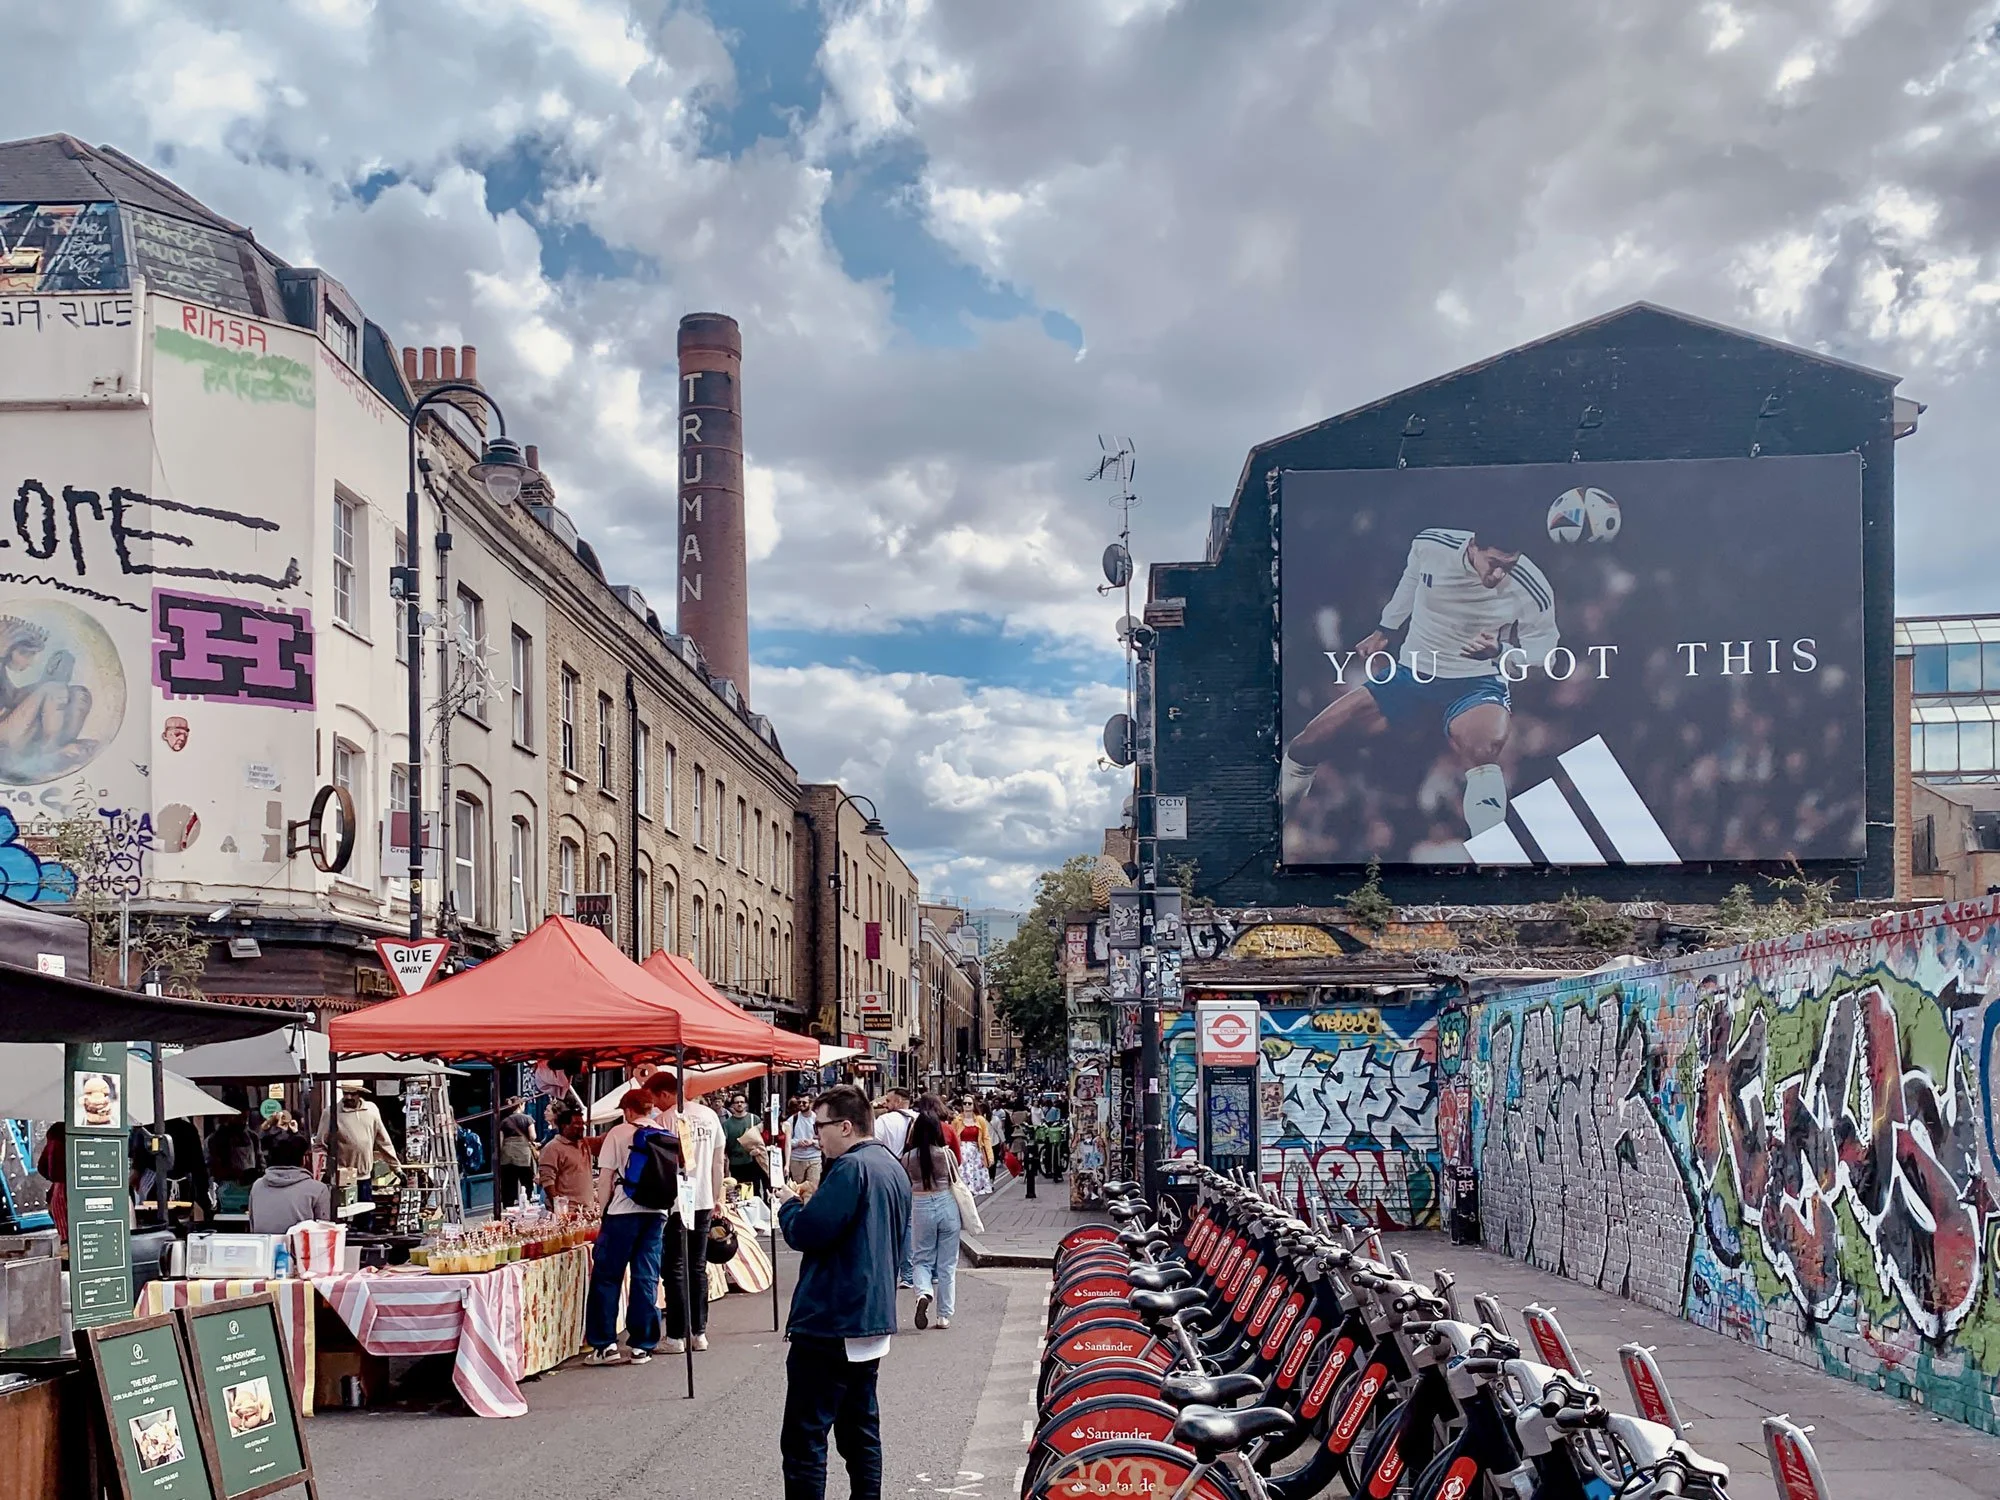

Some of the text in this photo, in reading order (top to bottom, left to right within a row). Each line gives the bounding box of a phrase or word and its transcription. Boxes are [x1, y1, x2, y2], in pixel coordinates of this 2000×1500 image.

[182, 306, 267, 353] RIKSA
[682, 373, 703, 602] TRUMAN
[1323, 638, 1819, 685] YOU GOT THIS
[1158, 798, 1184, 807] CCTV
[578, 913, 612, 925] CAB
[394, 950, 432, 963] GIVE
[400, 966, 422, 974] AWAY
[1082, 1289, 1121, 1298] Santander
[1273, 1317, 1289, 1342] Santander
[1084, 1341, 1134, 1352] Santander
[1289, 1345, 1306, 1371] Santander
[1315, 1368, 1335, 1397] Santander
[1344, 1397, 1366, 1428] Santander
[1086, 1426, 1152, 1439] Santander
